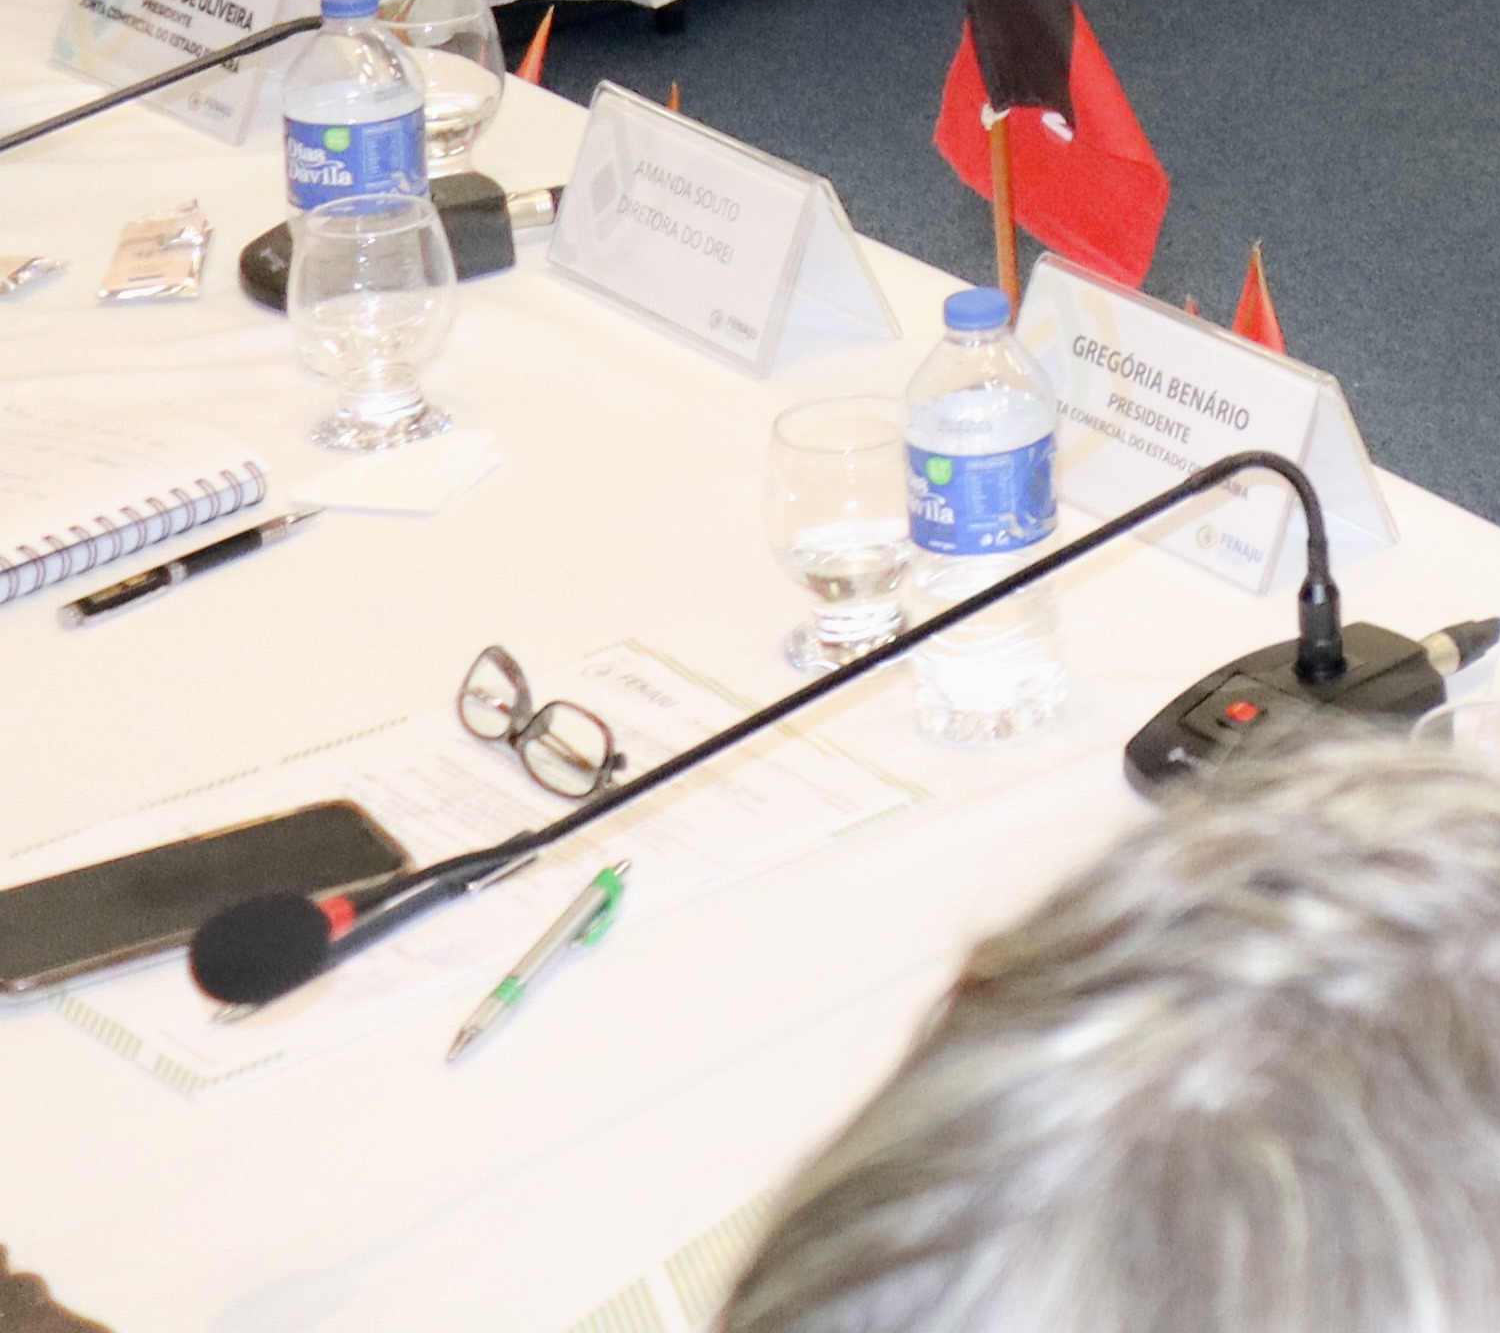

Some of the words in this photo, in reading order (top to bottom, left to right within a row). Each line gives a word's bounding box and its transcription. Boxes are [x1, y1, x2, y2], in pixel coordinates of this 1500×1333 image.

[105, 2, 154, 38] COMERCIAL
[154, 28, 169, 45] DO
[633, 159, 694, 203] AMANDA
[694, 184, 740, 222] SOUTO
[615, 193, 680, 243] DIRETORA
[680, 224, 703, 251] DO
[702, 233, 736, 267] DREI
[1072, 335, 1162, 395] GREGÓRIA
[1165, 376, 1251, 432] BENÁRIO
[1069, 406, 1128, 446] COMERCIAL
[1127, 434, 1145, 452] DO
[1144, 442, 1195, 473] ESTADO
[1107, 391, 1192, 445] PRESIDENTE
[1218, 532, 1265, 565] FENAJU
